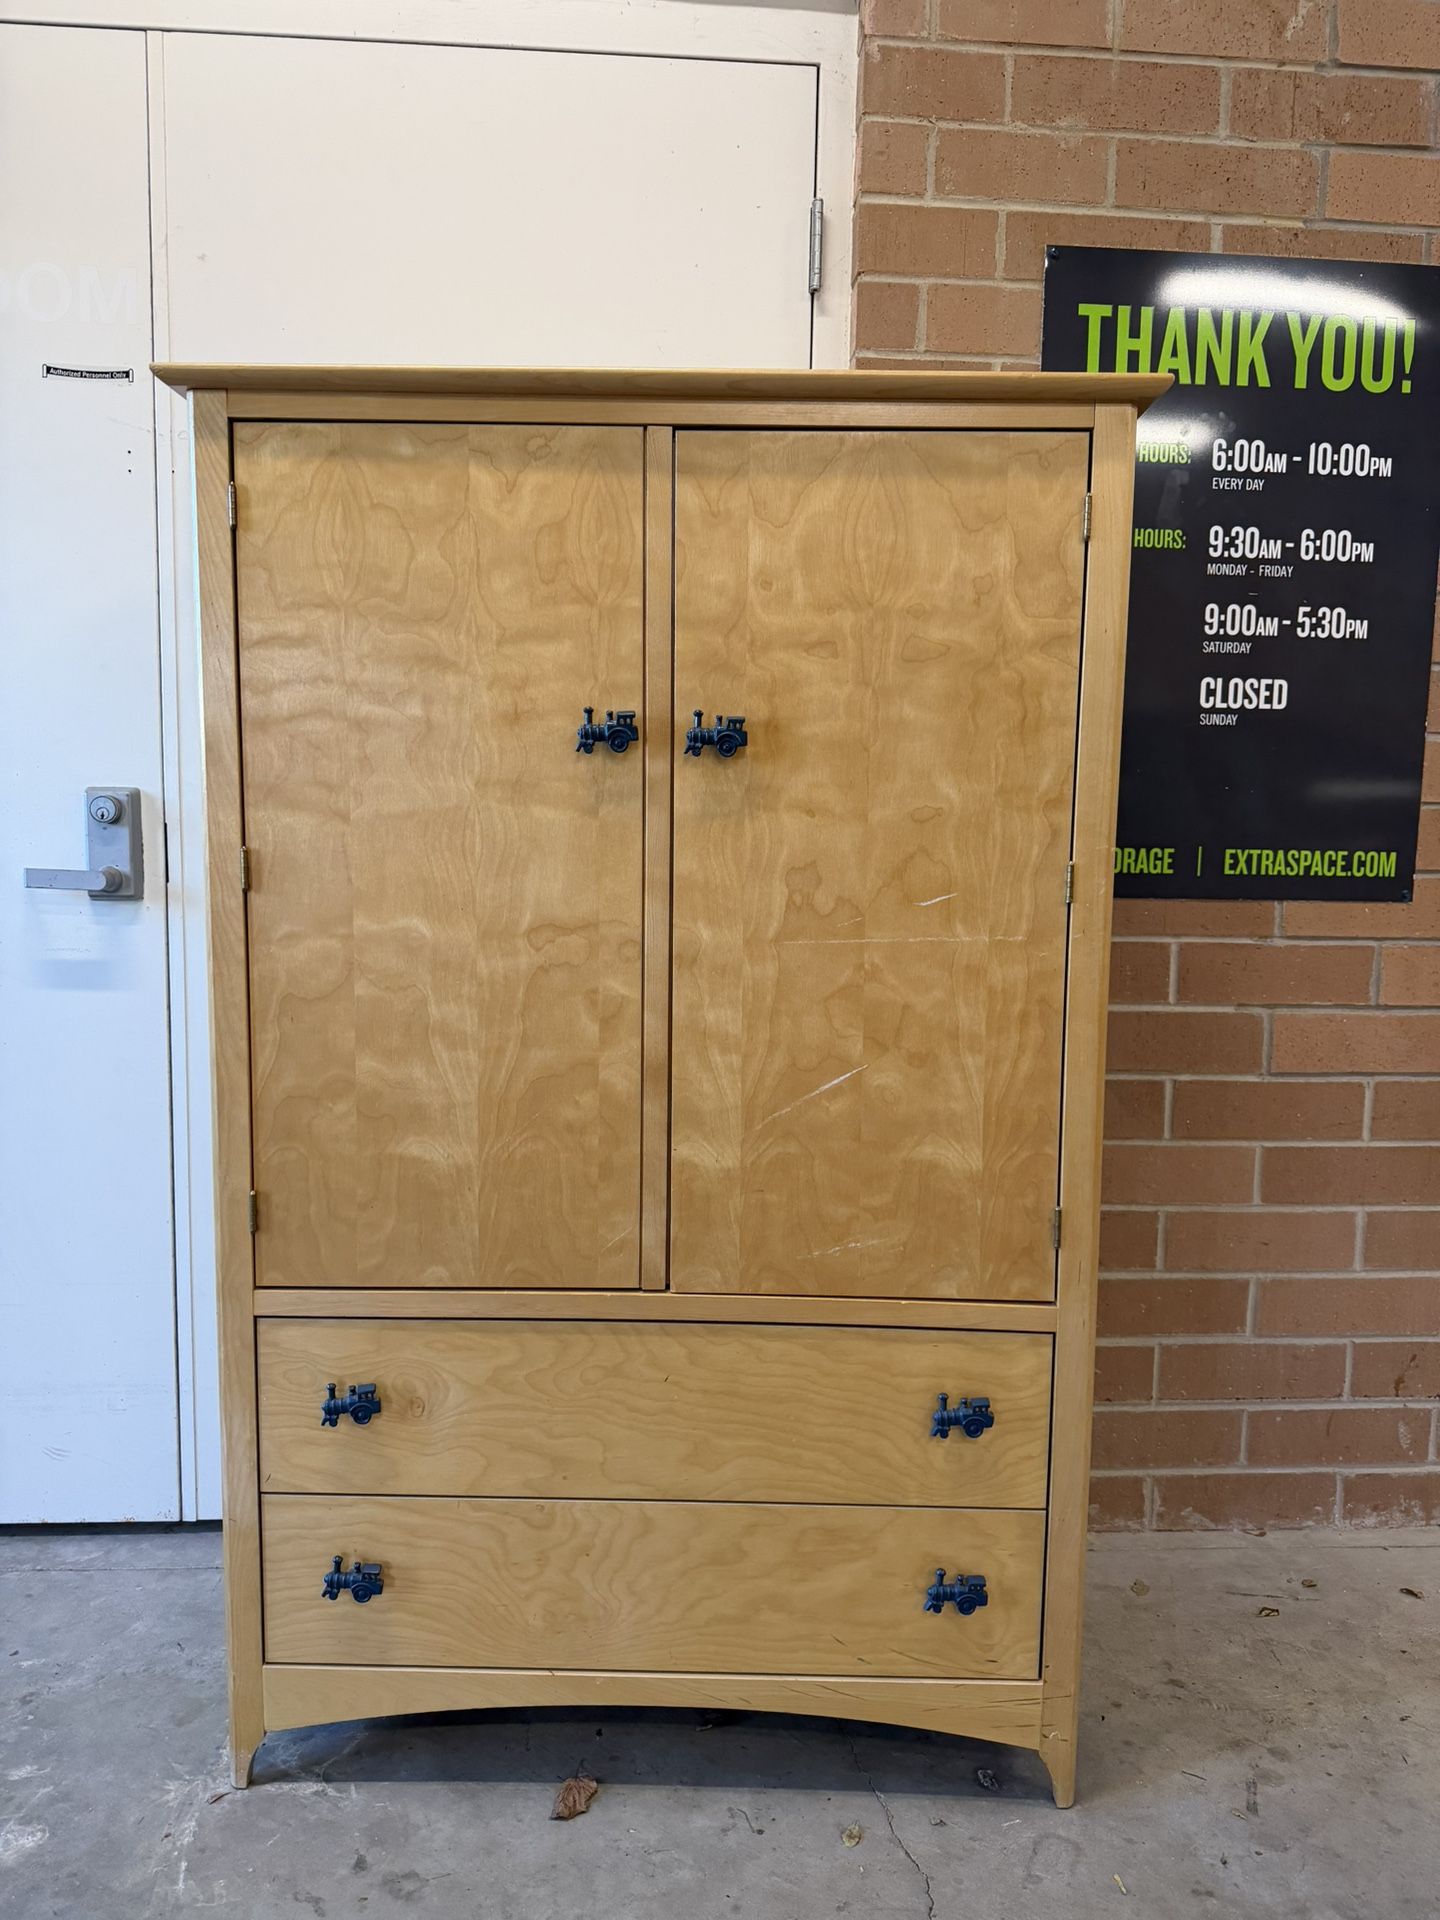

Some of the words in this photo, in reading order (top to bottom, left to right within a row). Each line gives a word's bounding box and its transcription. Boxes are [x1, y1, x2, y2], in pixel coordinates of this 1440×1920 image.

[0, 261, 137, 324] OM
[1078, 303, 1275, 388] THANK
[1286, 311, 1417, 394] YOU!
[49, 367, 80, 378] Authorized
[82, 371, 111, 379] Personnel
[1138, 442, 1192, 465] HOURS:
[1212, 438, 1287, 473] 6:00AM
[1308, 442, 1392, 477] 10:00PM
[1212, 477, 1243, 491] EVERY
[1246, 478, 1265, 491] DAY
[1133, 528, 1187, 549] HOURS:
[1208, 525, 1282, 559] 9:30AM
[1300, 528, 1374, 562] 6:00PM
[1207, 563, 1248, 576] MONDAY
[1258, 565, 1294, 578] FRIDAY
[1203, 603, 1278, 637] 9:00AM
[1297, 606, 1368, 640] 5:30PM
[1202, 641, 1252, 654] SATURDAY
[1199, 676, 1288, 710] CLOSED
[1199, 713, 1239, 726] SUNDAY
[1224, 849, 1396, 878] EXTRASPACE.COM
